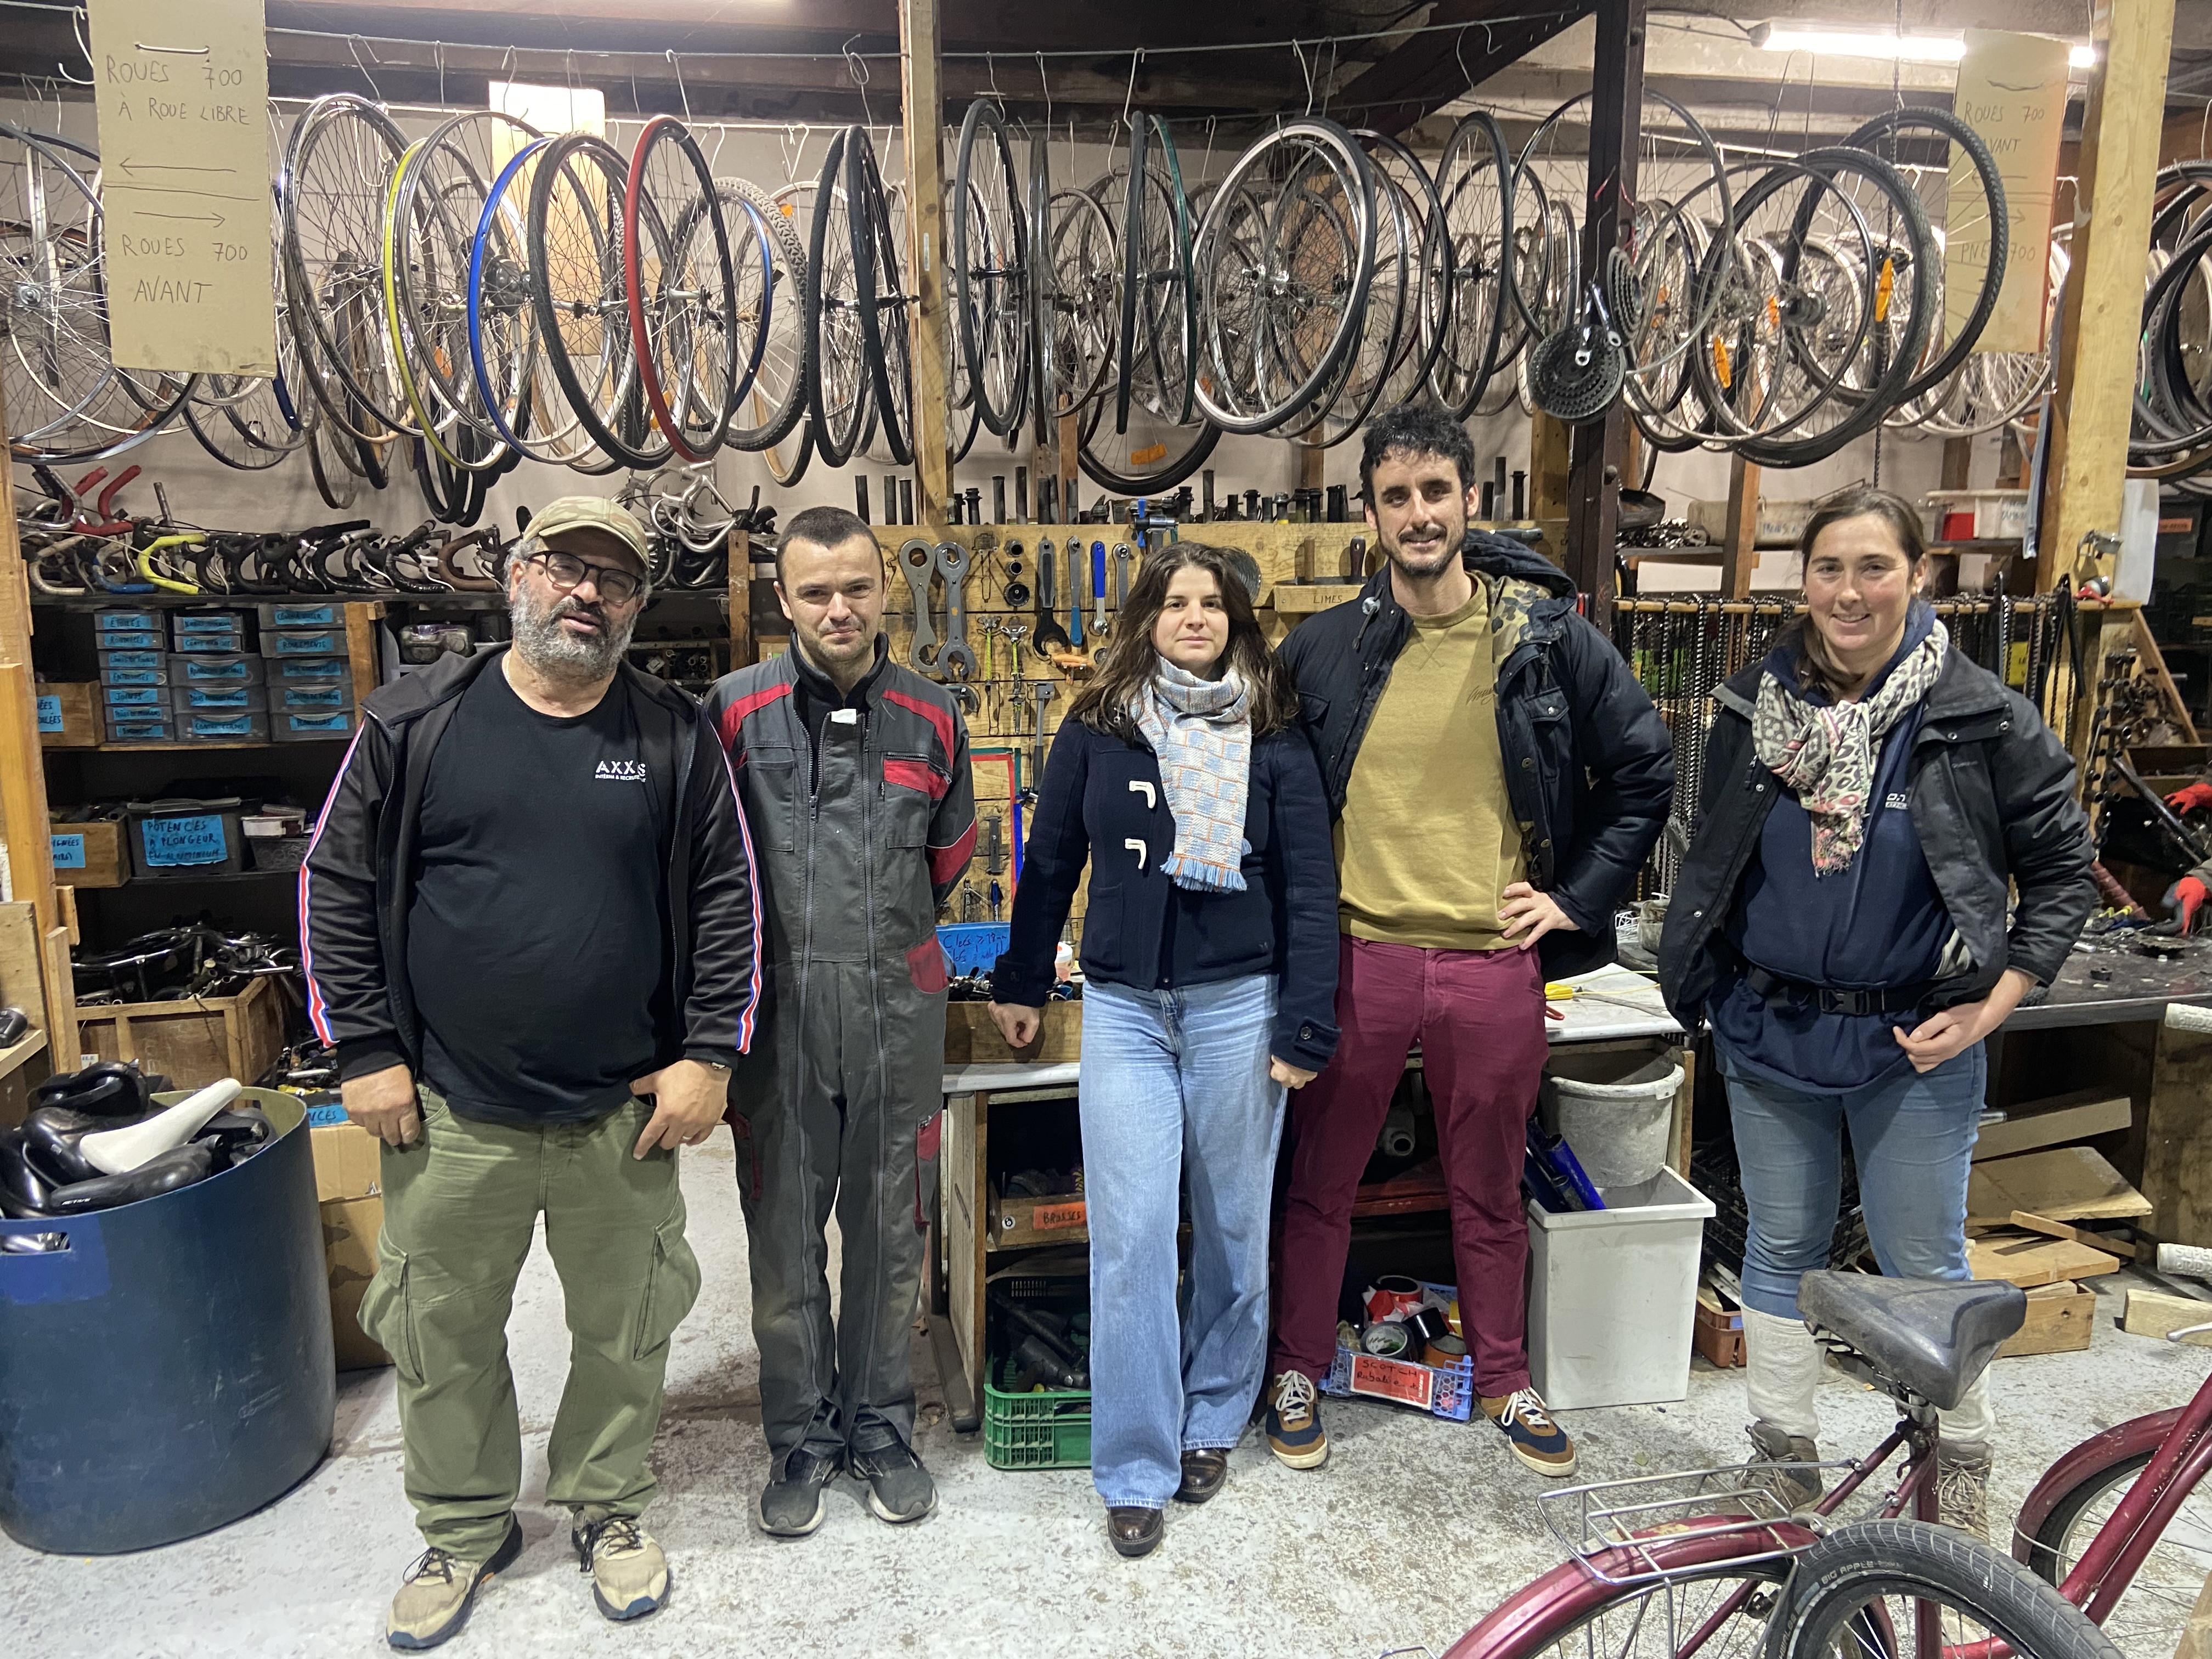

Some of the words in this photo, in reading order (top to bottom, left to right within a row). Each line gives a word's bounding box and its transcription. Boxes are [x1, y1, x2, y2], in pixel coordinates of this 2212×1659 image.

[106, 55, 168, 83] ROUES
[201, 66, 242, 90] 700
[119, 91, 132, 121] À
[149, 97, 186, 121] ROUE
[200, 105, 250, 125] LIBRE
[1963, 101, 2003, 126] ROUES
[2022, 105, 2045, 125] 700
[122, 234, 184, 257] ROUES
[212, 242, 247, 262] 700
[2010, 242, 2036, 264] 700
[134, 275, 212, 303] AVANT
[1313, 595, 1343, 604] LIMES
[148, 820, 207, 833] POTENCES
[161, 833, 217, 847] PLONGEUR
[1362, 1359, 1417, 1378] SCOTCH
[1821, 1570, 1837, 1585] BIG
[1839, 1560, 1874, 1575] APPLE
